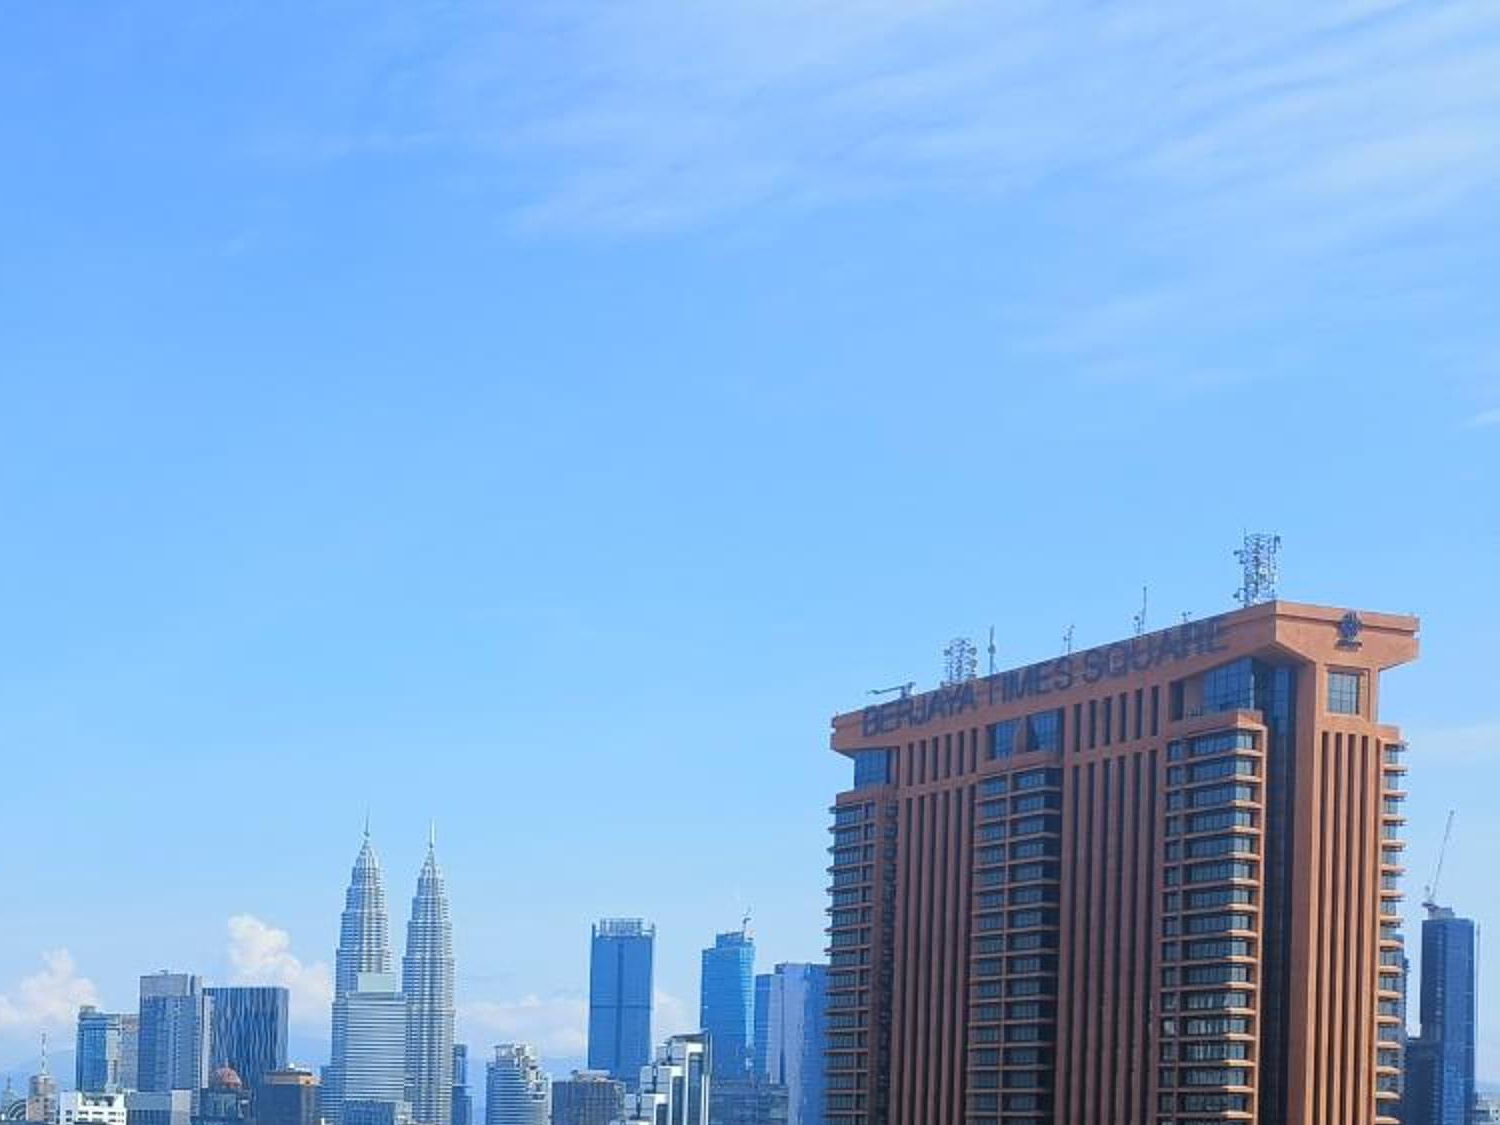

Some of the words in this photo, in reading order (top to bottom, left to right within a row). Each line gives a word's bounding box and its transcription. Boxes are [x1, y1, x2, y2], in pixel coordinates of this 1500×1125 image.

[862, 681, 979, 737] BERJAYA
[989, 657, 1072, 705] TIMES
[1080, 617, 1230, 684] SQUARE
